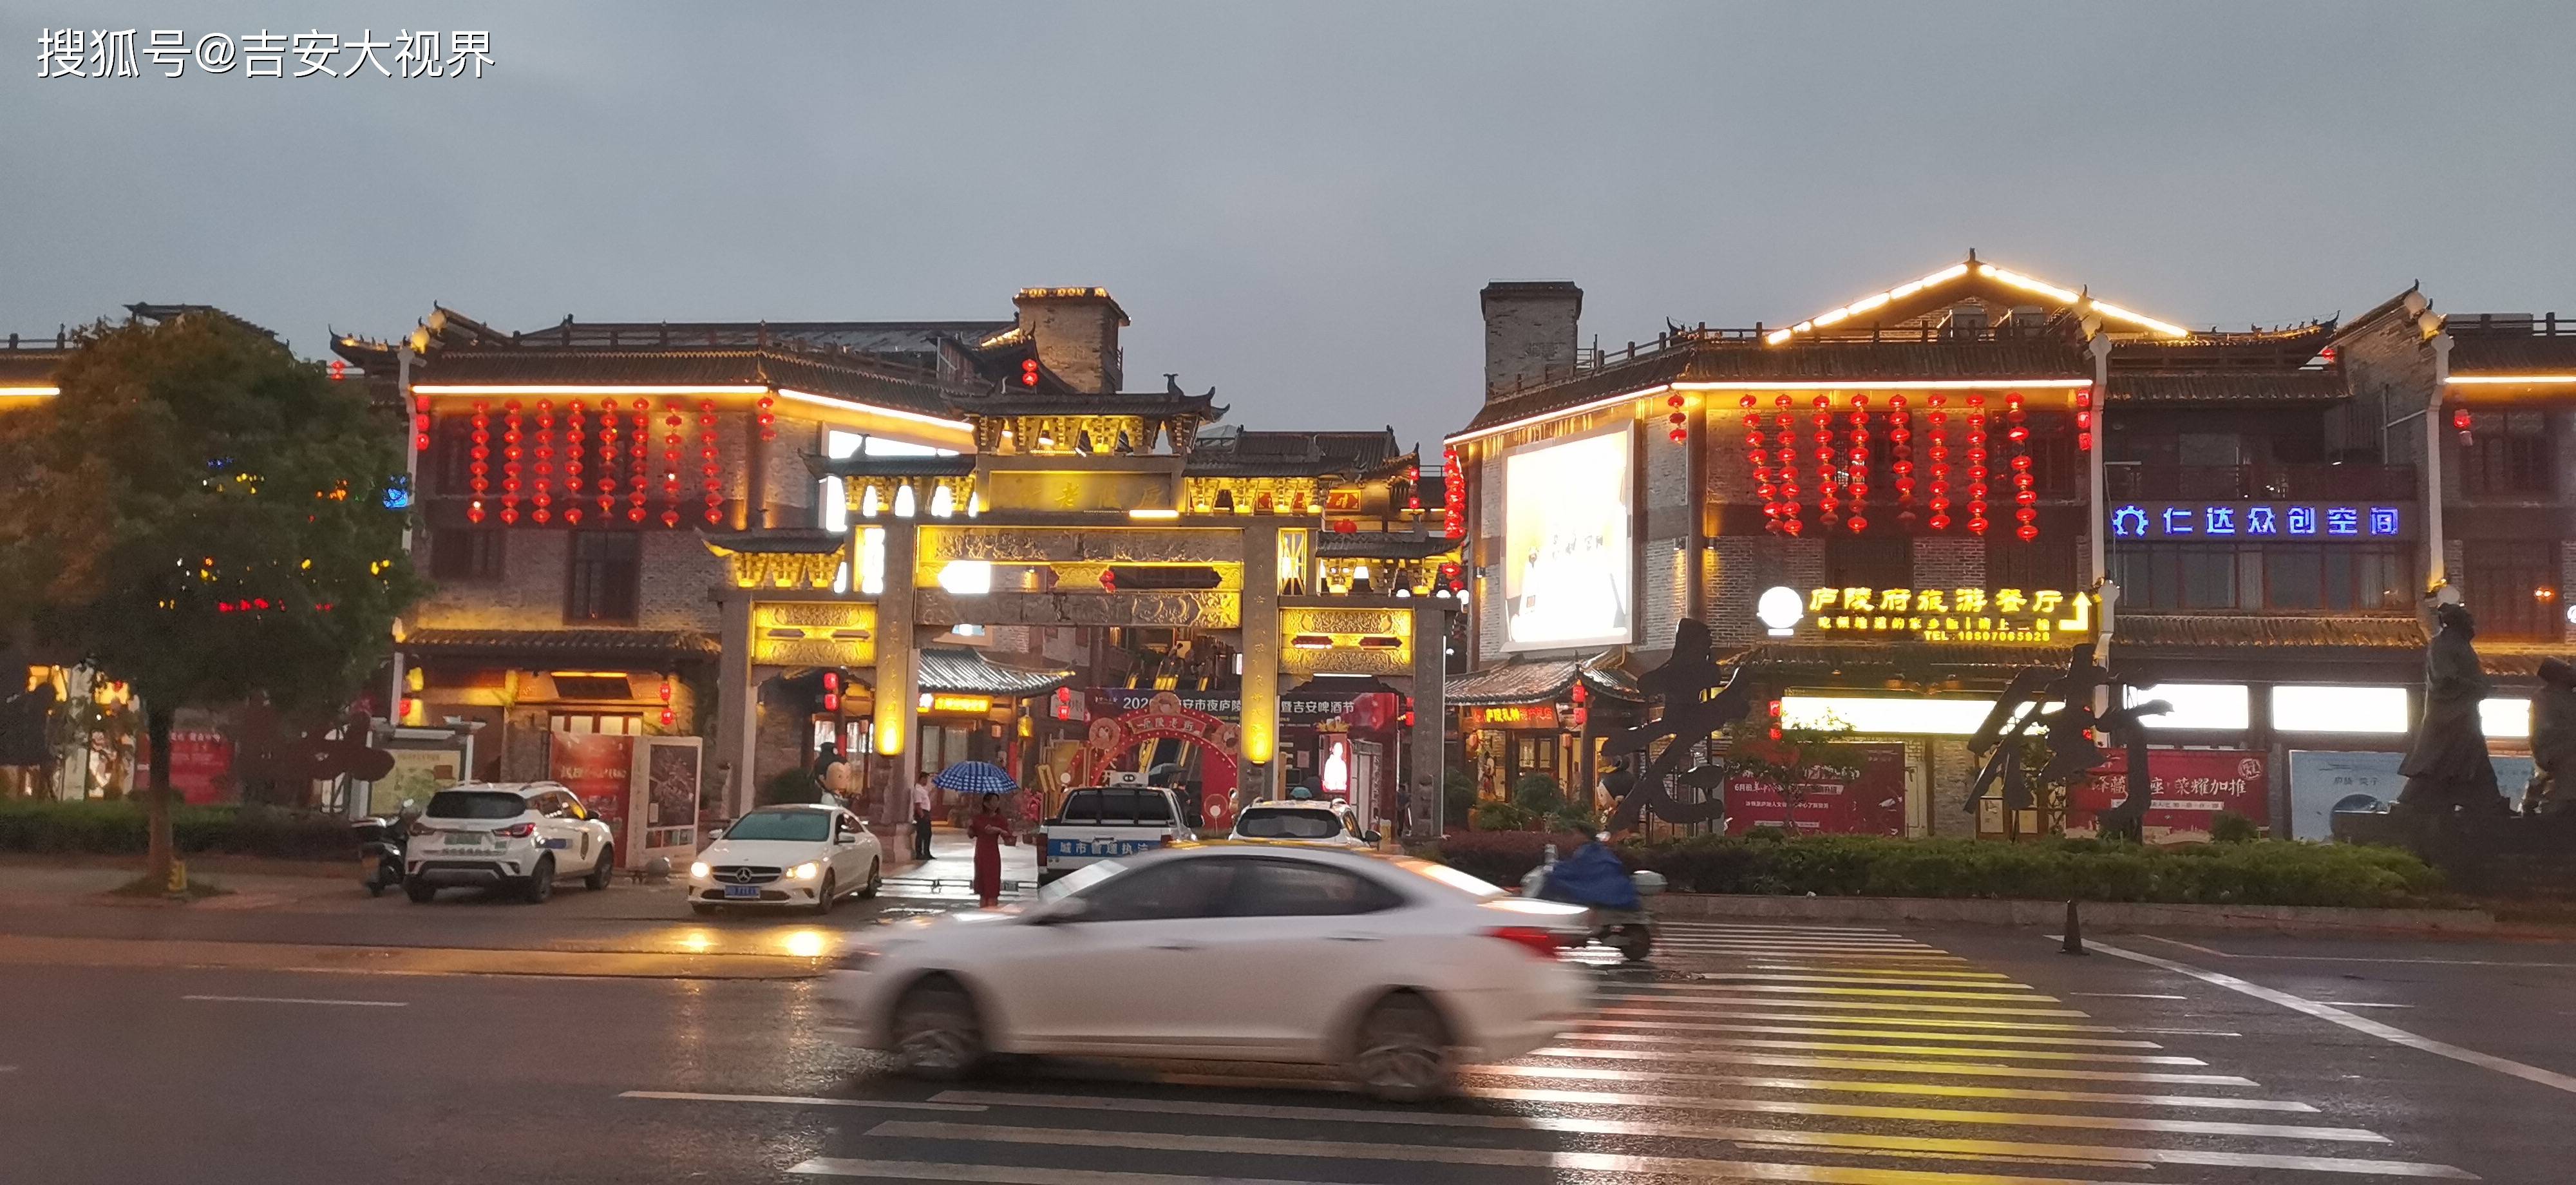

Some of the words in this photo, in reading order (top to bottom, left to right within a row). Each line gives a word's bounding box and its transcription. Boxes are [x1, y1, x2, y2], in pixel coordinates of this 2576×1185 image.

[2163, 506, 2399, 535] 仁达众创空间
[1809, 587, 2063, 612] 庐陵府旅游餐厅
